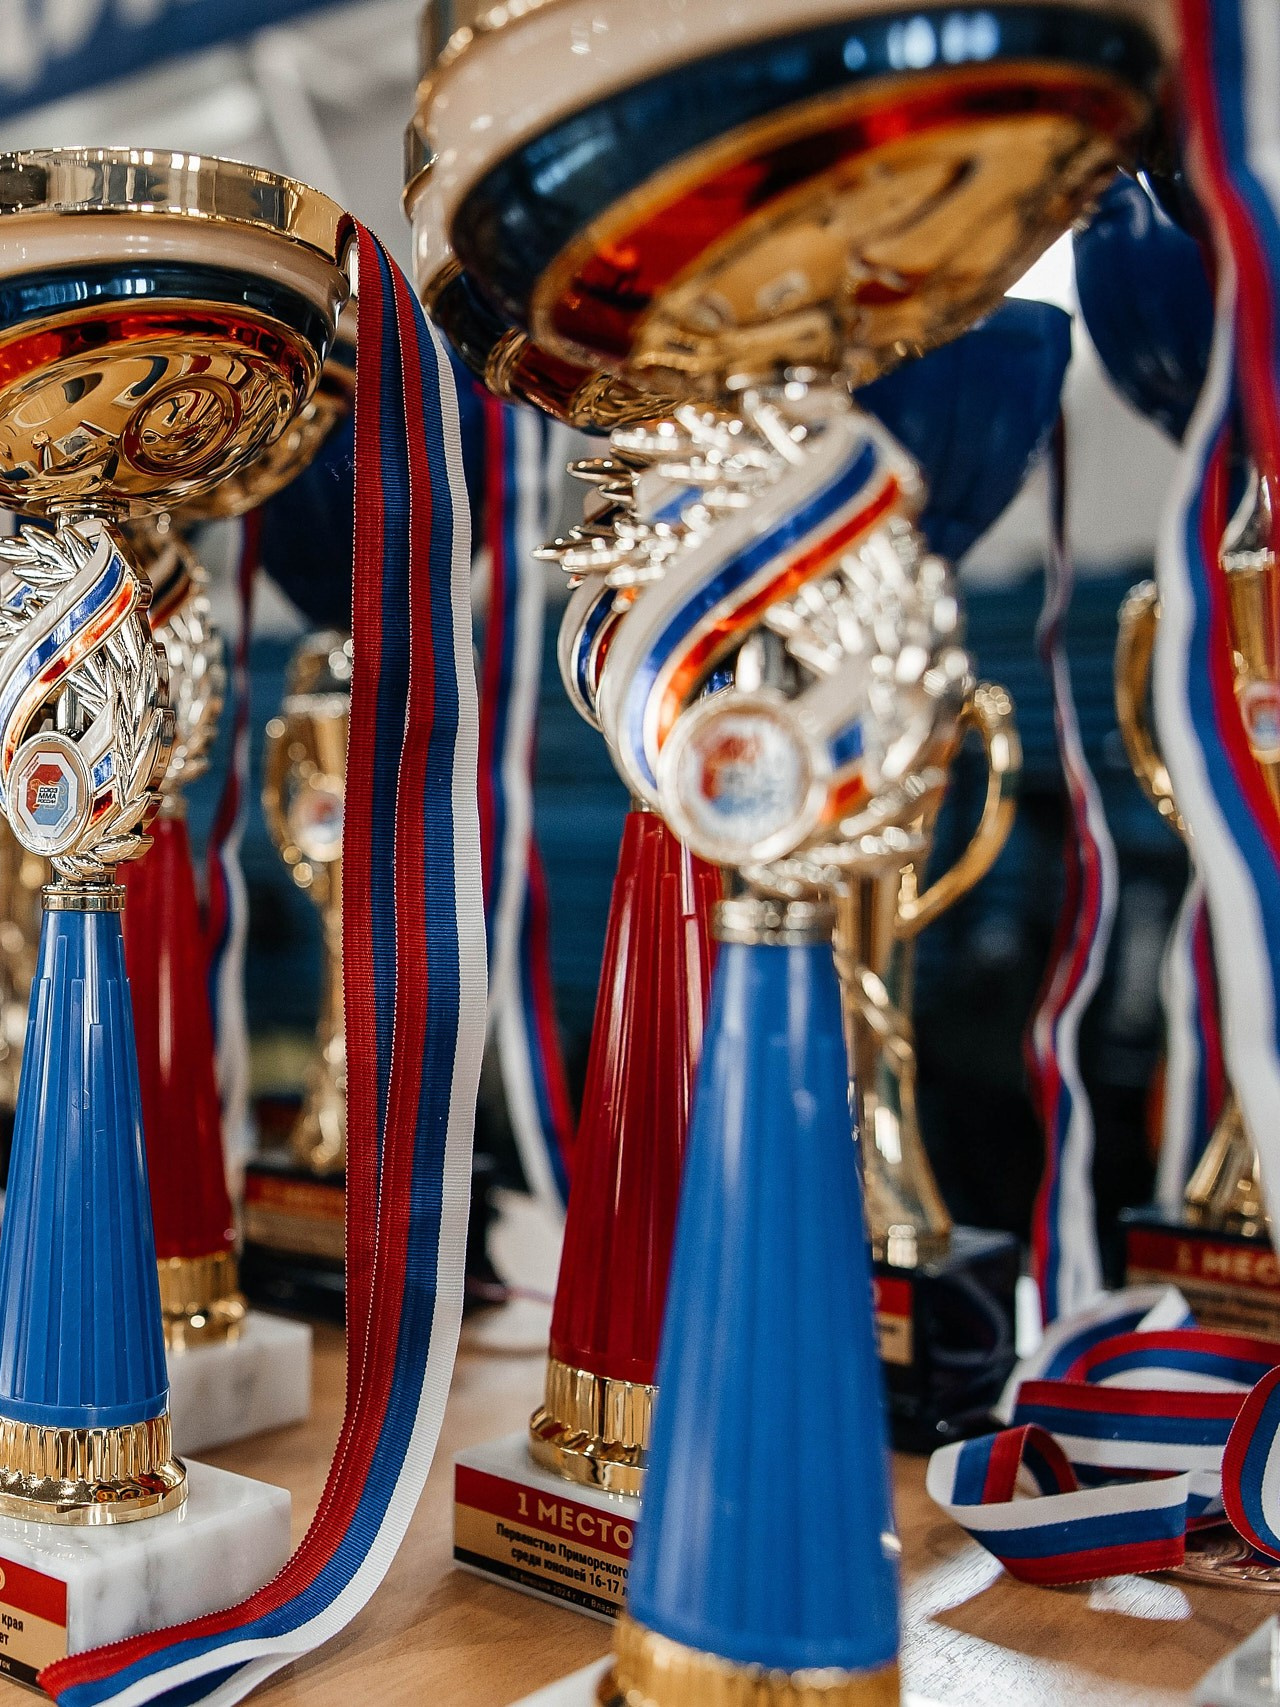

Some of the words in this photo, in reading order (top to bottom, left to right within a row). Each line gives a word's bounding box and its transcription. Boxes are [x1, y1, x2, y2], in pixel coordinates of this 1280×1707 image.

[517, 1492, 528, 1516] 1
[538, 1499, 634, 1549] МЕСТО
[496, 1523, 556, 1553] Первенство
[558, 1543, 629, 1579] Приморского
[512, 1548, 541, 1567] среди
[544, 1559, 586, 1583] юношей
[589, 1573, 620, 1593] 16-17
[1, 1613, 24, 1633] края
